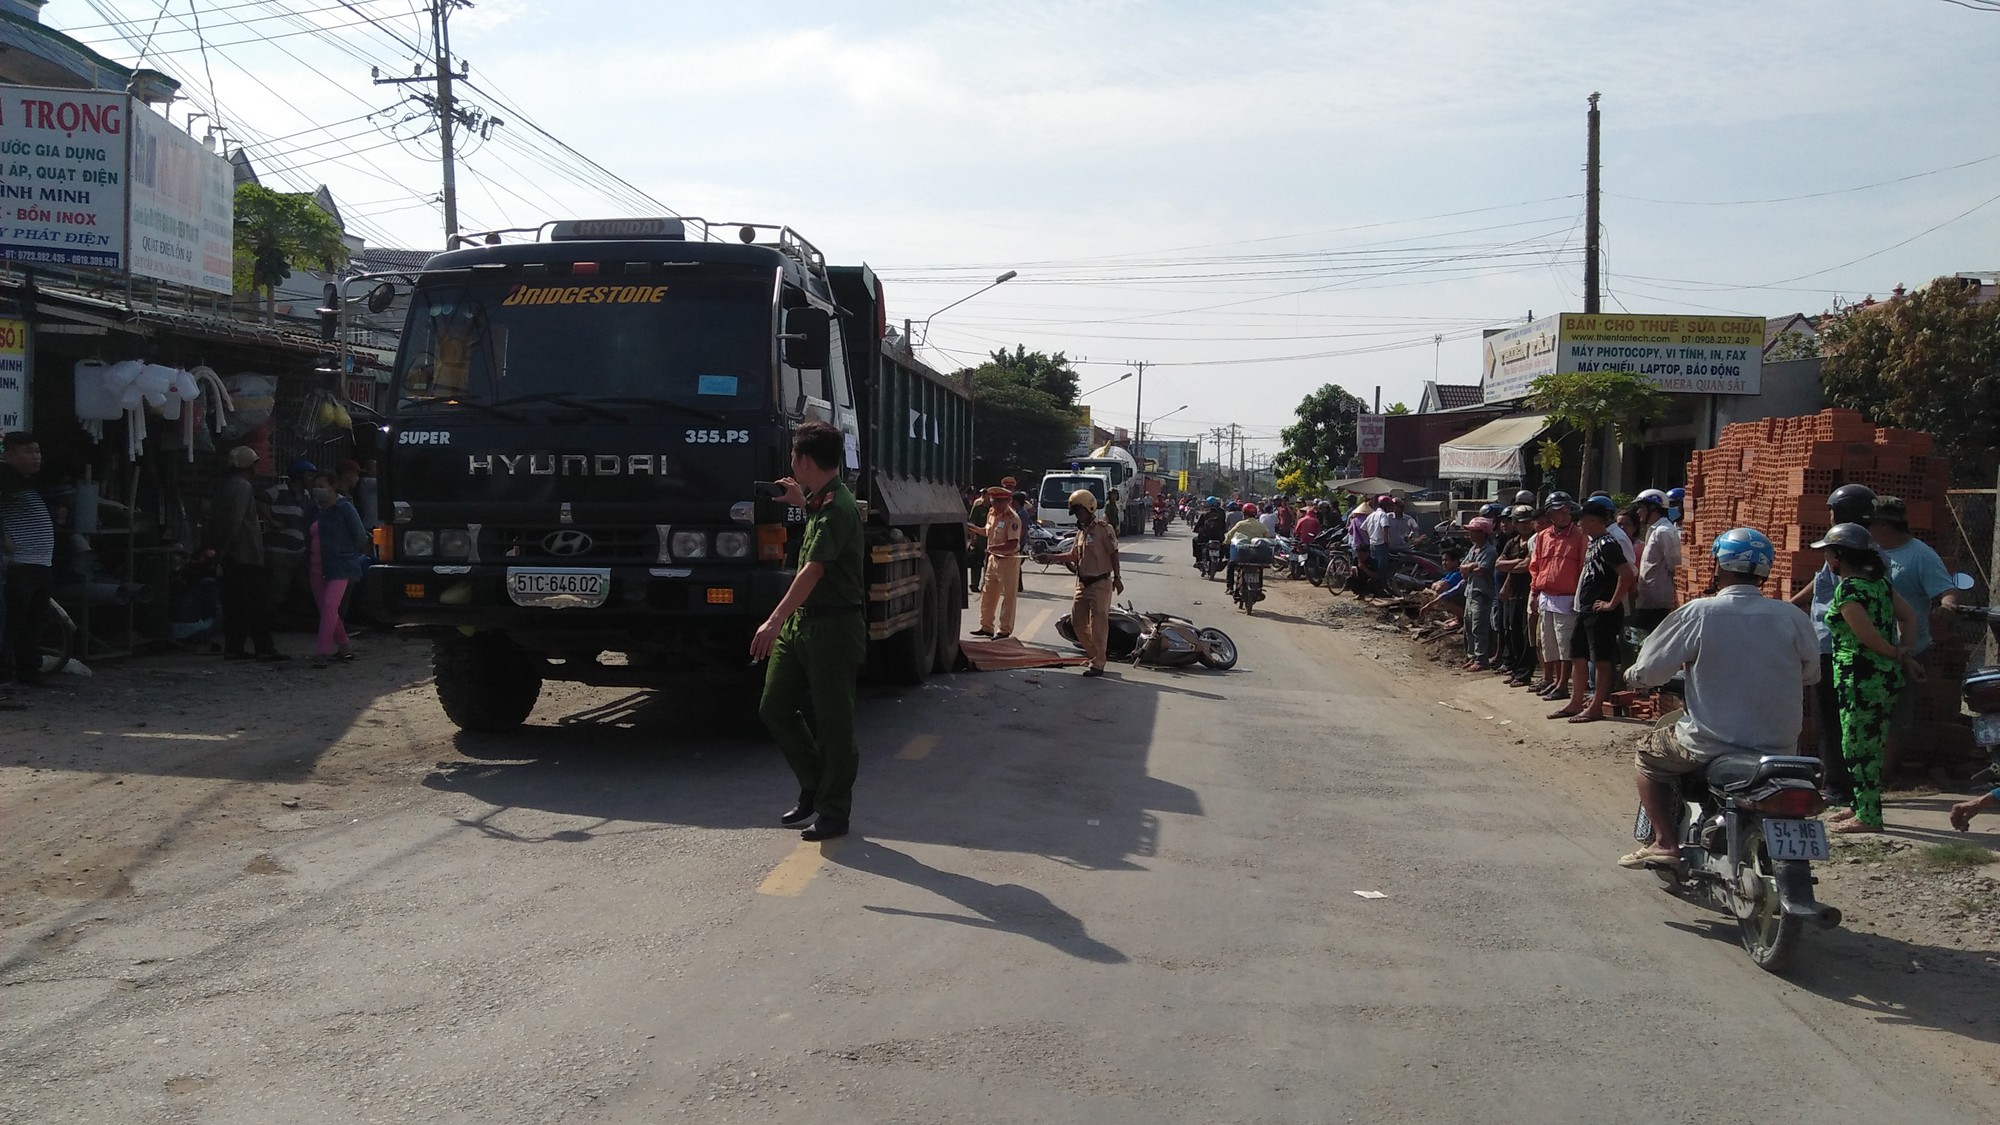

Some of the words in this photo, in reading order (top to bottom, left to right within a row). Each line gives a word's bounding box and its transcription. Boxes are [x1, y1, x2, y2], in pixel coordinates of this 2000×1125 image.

[20, 99, 120, 138] TRỌNG
[36, 144, 60, 158] GIA
[66, 146, 106, 163] DỤNG
[36, 166, 76, 184] QUẠT
[82, 168, 118, 186] ĐIỆN
[40, 188, 90, 204] MINH
[18, 204, 50, 222] BỒN
[56, 212, 96, 226] INOX
[580, 219, 663, 234] HYUNDAI
[13, 228, 61, 242] PHÁT
[64, 232, 110, 247] ĐIỆN
[502, 284, 668, 306] BRIDGESTONE
[1566, 316, 1596, 330] BÁN
[1604, 319, 1635, 332] CHO
[1640, 318, 1679, 332] THUÊ
[1688, 318, 1716, 333] SỬA
[1722, 319, 1762, 334] CHỮA
[1572, 334, 1670, 342] www.thientantech.com
[1572, 344, 1594, 356] MÁY
[1597, 346, 1662, 359] PHOTOCOPY,
[1666, 349, 1676, 358] VI
[1680, 347, 1706, 360] TÍNH,
[1726, 350, 1746, 360] FAX
[1578, 360, 1600, 372] MÁY
[1640, 364, 1683, 376] LAPTOP,
[1686, 362, 1707, 375] BÁO
[1711, 363, 1740, 378] ĐỘNG
[1696, 380, 1724, 391] QUAN
[1727, 379, 1746, 391] SÁT
[399, 431, 450, 445] SUPER
[685, 430, 749, 443] 355.PS
[467, 455, 668, 476] HYUNDAI
[518, 576, 598, 592] 51C-646.02
[1773, 822, 1817, 838] 54-N6
[1776, 840, 1820, 856] 7476
